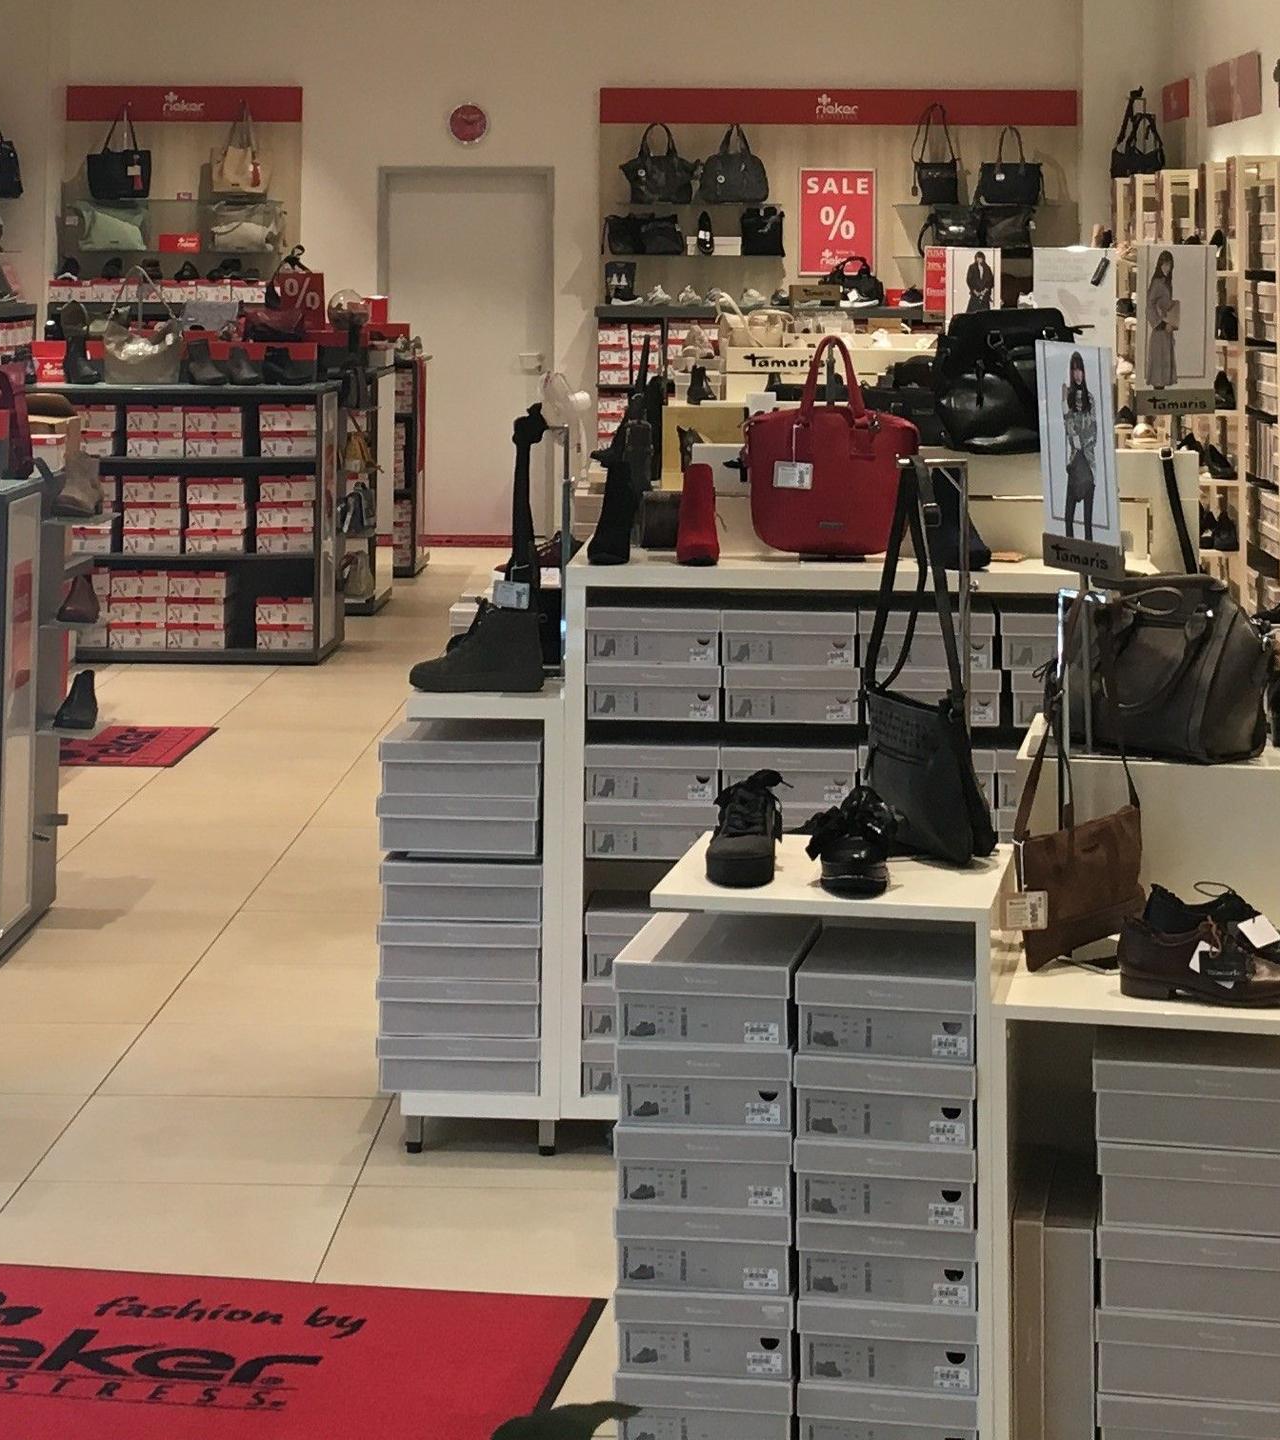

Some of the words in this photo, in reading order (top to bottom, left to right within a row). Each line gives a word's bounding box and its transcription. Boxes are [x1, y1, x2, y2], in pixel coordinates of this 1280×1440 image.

[806, 177, 869, 195] SALE
[820, 205, 856, 241] %
[93, 1295, 284, 1327] fashion
[303, 1305, 368, 1340] by
